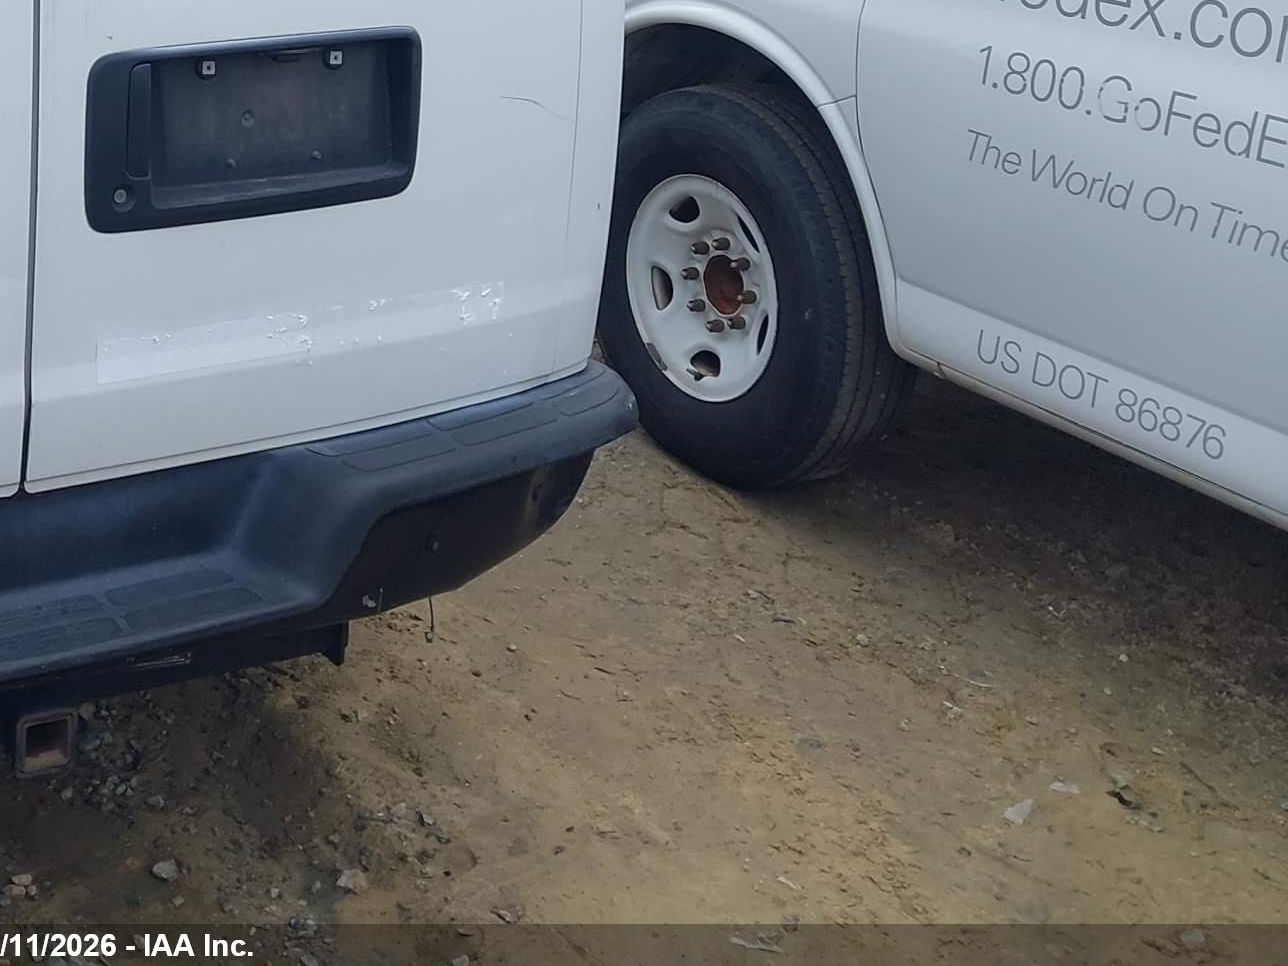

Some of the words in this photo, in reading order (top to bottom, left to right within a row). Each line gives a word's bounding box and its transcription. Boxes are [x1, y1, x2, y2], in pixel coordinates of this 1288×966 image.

[967, 129, 1022, 175] The
[1031, 149, 1135, 211] World
[1142, 186, 1199, 232] On
[977, 329, 1023, 375] US
[1031, 351, 1109, 409] DOT
[1115, 388, 1227, 460] 86876
